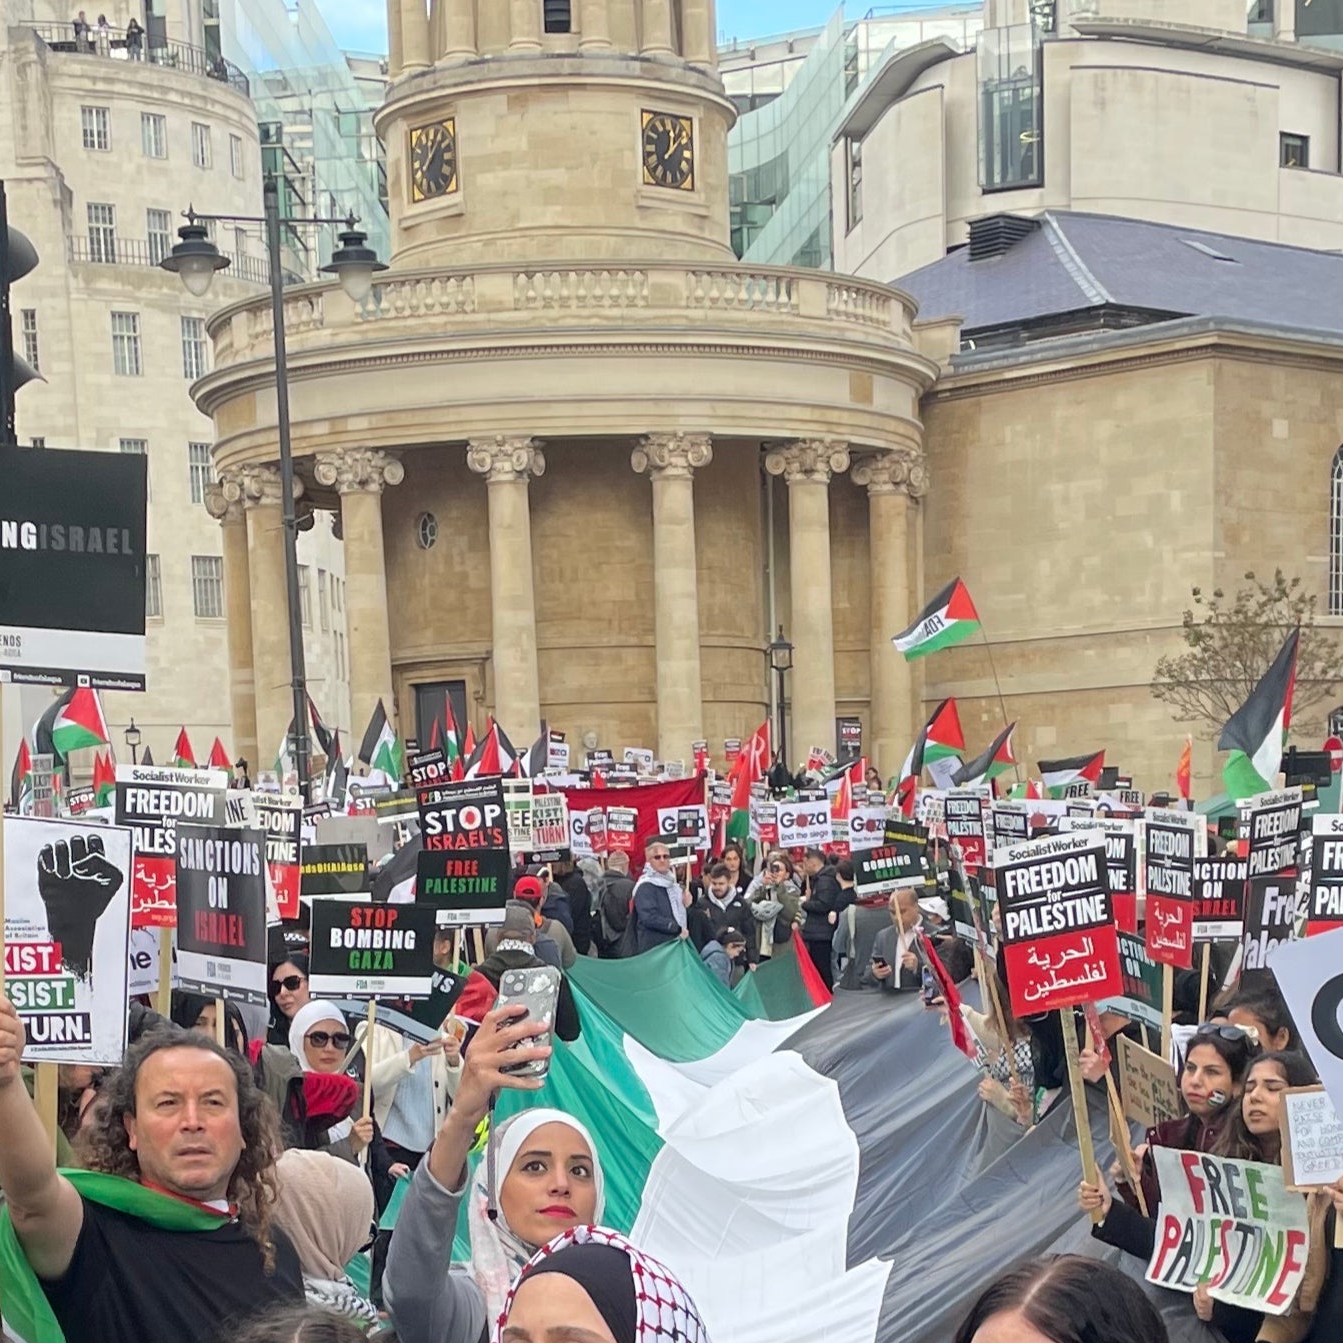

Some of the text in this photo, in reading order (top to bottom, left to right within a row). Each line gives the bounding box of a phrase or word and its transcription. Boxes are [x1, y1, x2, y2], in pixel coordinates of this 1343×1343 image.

[412, 763, 446, 782] STOP
[125, 788, 214, 818] FREEDOM
[160, 816, 177, 829] for
[425, 804, 501, 834] STOP
[1254, 807, 1300, 839] FREEDOM
[180, 837, 260, 876] SANCTIONS
[1149, 829, 1190, 858] FREEDOM
[446, 860, 478, 876] FREE
[1249, 842, 1298, 876] PALESTINE
[425, 877, 497, 894] PALESTINE
[1006, 854, 1098, 898] FREEDOM
[1148, 865, 1191, 896] PALESTINE
[1202, 881, 1223, 898] ON
[208, 875, 229, 909] ON
[1046, 889, 1062, 905] for
[195, 910, 245, 947] ISRAEL
[350, 907, 398, 927] STOP
[1005, 894, 1107, 939] PALESTINE
[330, 928, 416, 950] BOMBING
[1027, 937, 1095, 968] الحرية
[348, 950, 394, 970] GAZA
[1181, 1152, 1270, 1222] FREE
[1150, 1212, 1308, 1307] PALESTINE
